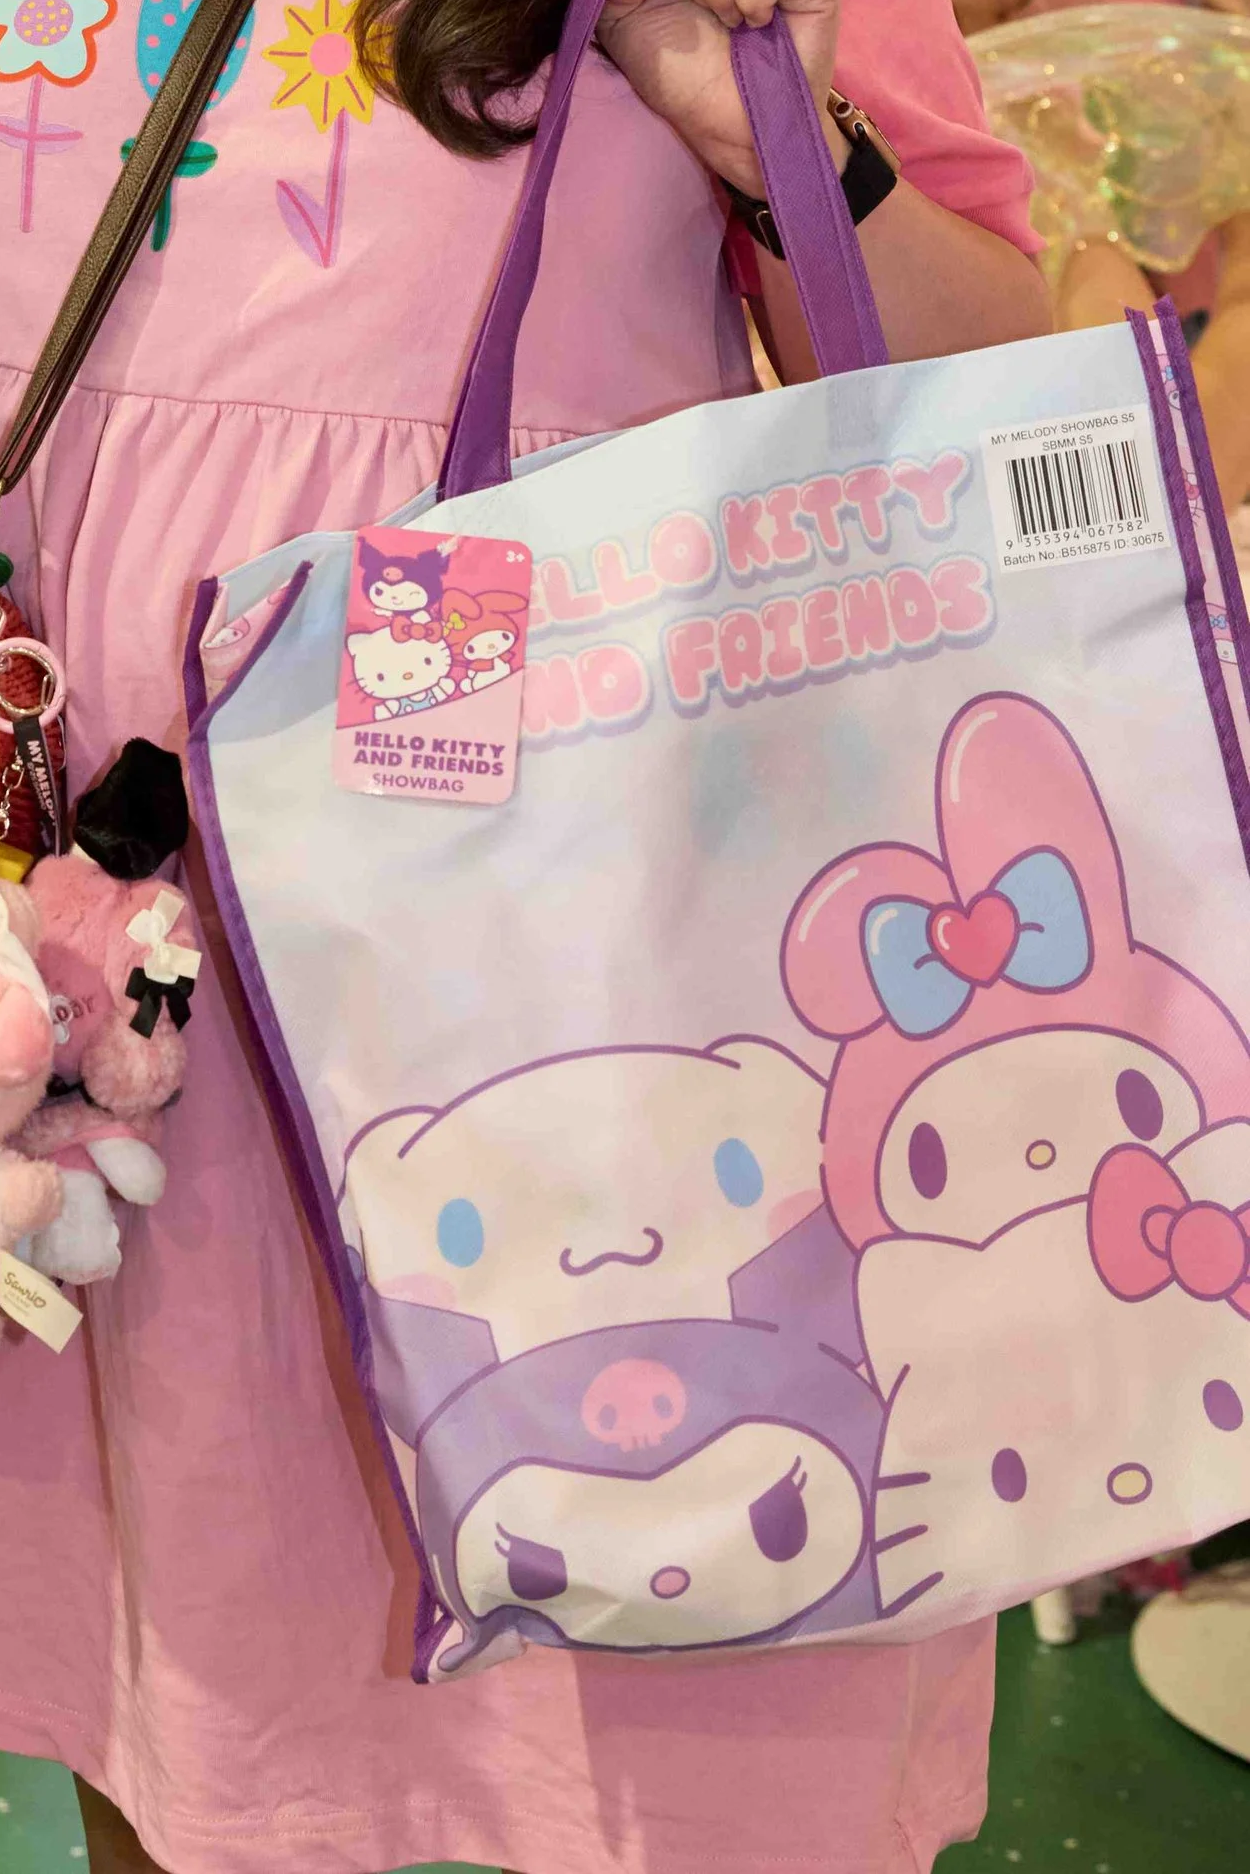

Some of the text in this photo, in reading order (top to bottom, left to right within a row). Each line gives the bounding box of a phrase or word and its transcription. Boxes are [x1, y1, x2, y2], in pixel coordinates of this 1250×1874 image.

[991, 413, 1135, 445] MY MELODY SHOWBAG S5
[1042, 434, 1094, 451] SBMM S5
[527, 450, 968, 631] LLO KITTY
[1003, 554, 1036, 566] Batch
[1132, 532, 1165, 547] 30675
[1024, 531, 1080, 548] 355394
[1088, 520, 1143, 538] 067582
[521, 556, 991, 734] ND FRIENDS
[27, 740, 44, 763] MY
[354, 731, 506, 759] HELLO KITTY
[353, 750, 504, 776] AND FRIENDS
[35, 767, 56, 825] MELOD
[372, 773, 464, 792] SHOWBAG
[4, 1272, 46, 1308] Sanrio
